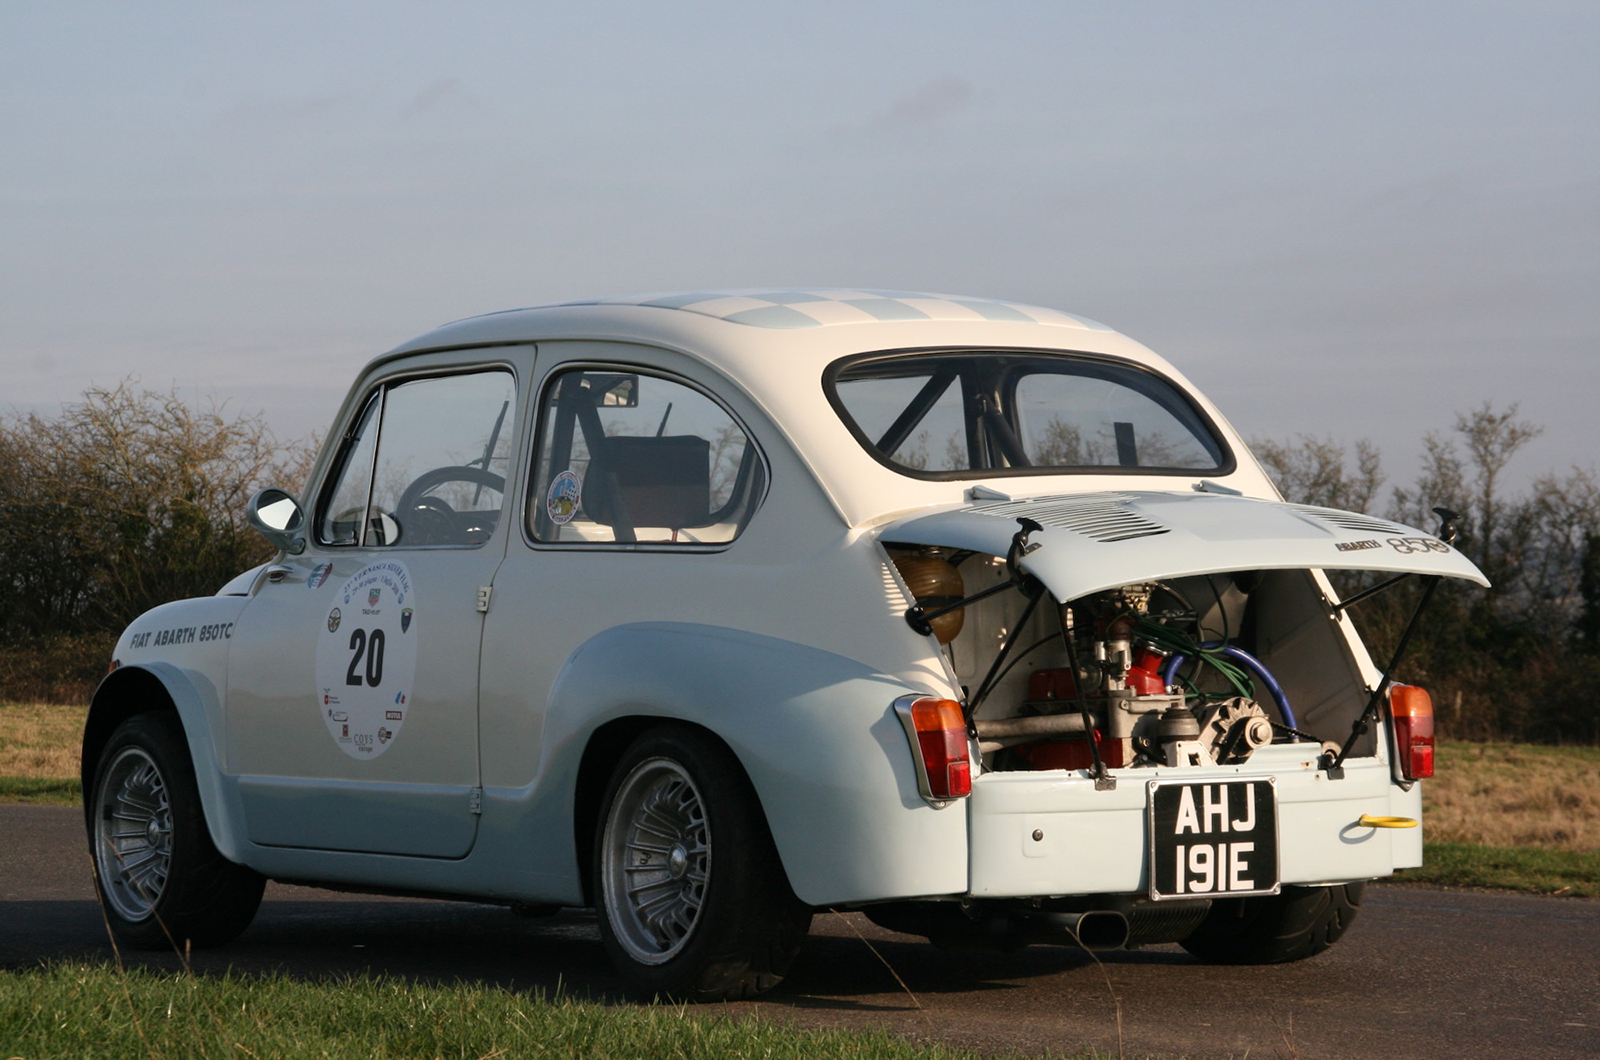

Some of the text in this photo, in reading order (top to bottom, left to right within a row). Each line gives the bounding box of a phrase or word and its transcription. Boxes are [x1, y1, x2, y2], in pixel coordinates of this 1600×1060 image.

[1334, 537, 1451, 554] ABARTH 850
[129, 622, 234, 649] FIAT ABARTH 850TC
[346, 628, 385, 688] 20
[353, 733, 373, 744] COYS
[1175, 783, 1256, 835] AHJ
[1176, 842, 1254, 894] 191E
